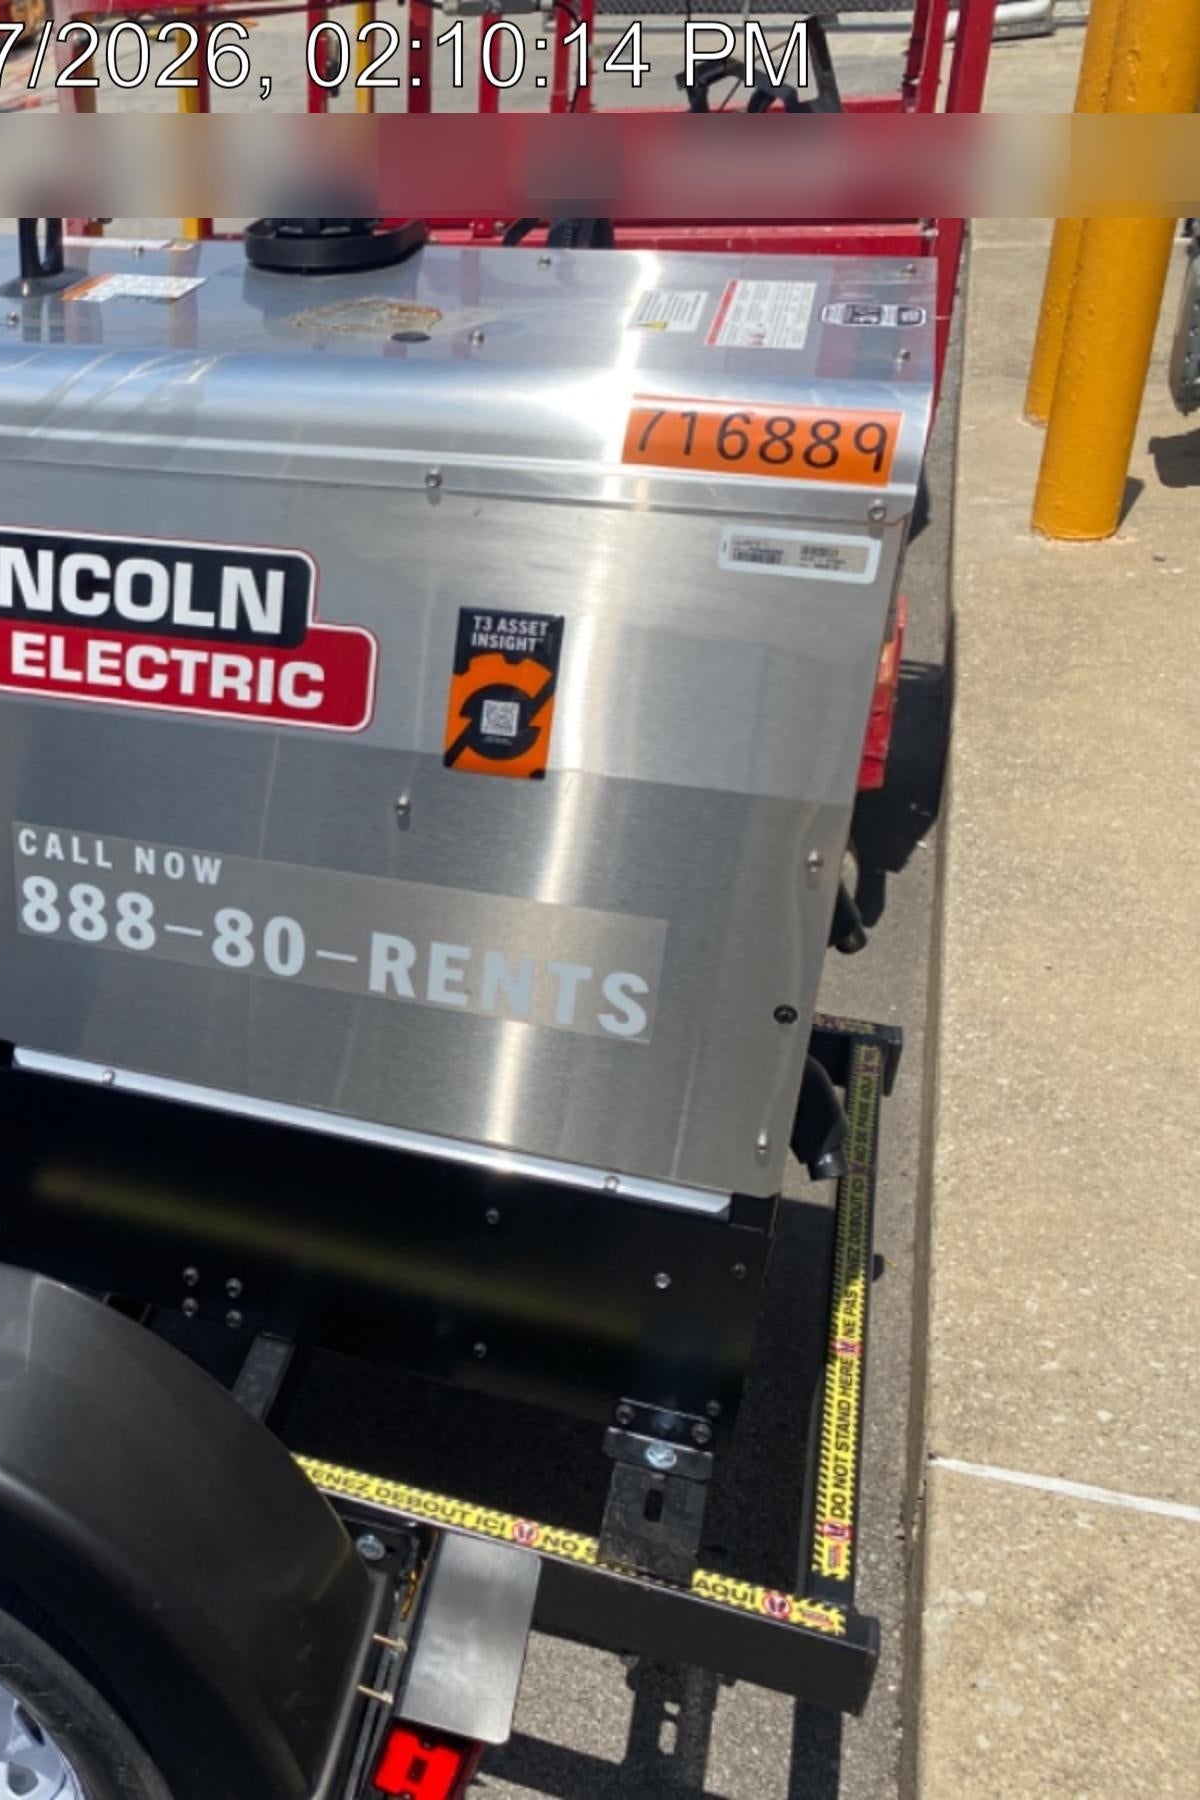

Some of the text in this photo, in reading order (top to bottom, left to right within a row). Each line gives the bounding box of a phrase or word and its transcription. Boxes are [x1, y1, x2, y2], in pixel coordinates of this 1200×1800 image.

[636, 408, 889, 473] 716889
[473, 615, 550, 637] T3 ASSET
[10, 630, 326, 710] ELECTRIC
[18, 828, 224, 886] CALL NOW
[21, 875, 651, 1038] 888-80-RENTS
[843, 1290, 857, 1316] PAS
[830, 1358, 854, 1520] DO NOT STAND HERE
[375, 1486, 476, 1523] DEBOUT
[477, 1514, 507, 1531] ICI
[542, 1534, 579, 1553] NO
